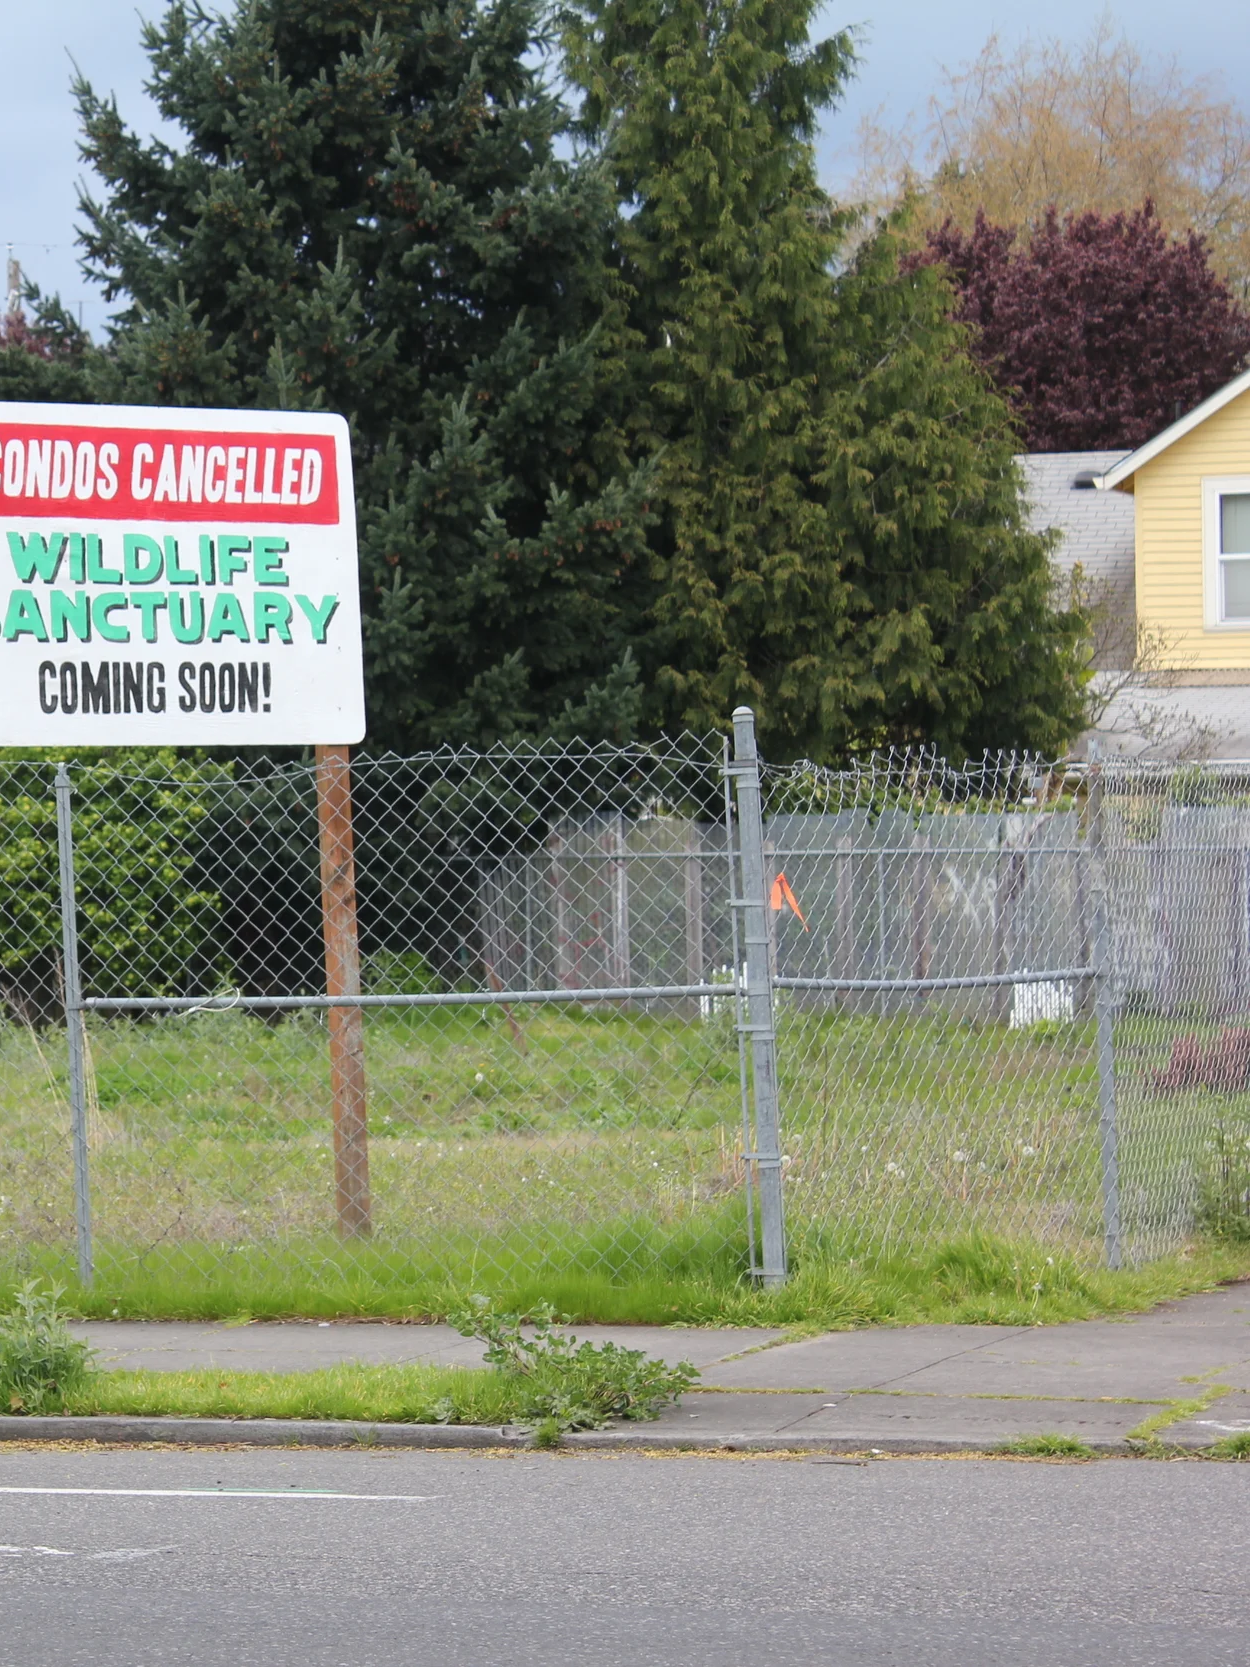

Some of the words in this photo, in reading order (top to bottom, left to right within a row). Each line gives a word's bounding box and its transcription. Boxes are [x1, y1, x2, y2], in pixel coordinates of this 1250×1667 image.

[131, 443, 323, 505] CANCELLED
[6, 531, 289, 586] WILDLIFE
[38, 660, 166, 714] COMING
[178, 662, 272, 713] SOON!
